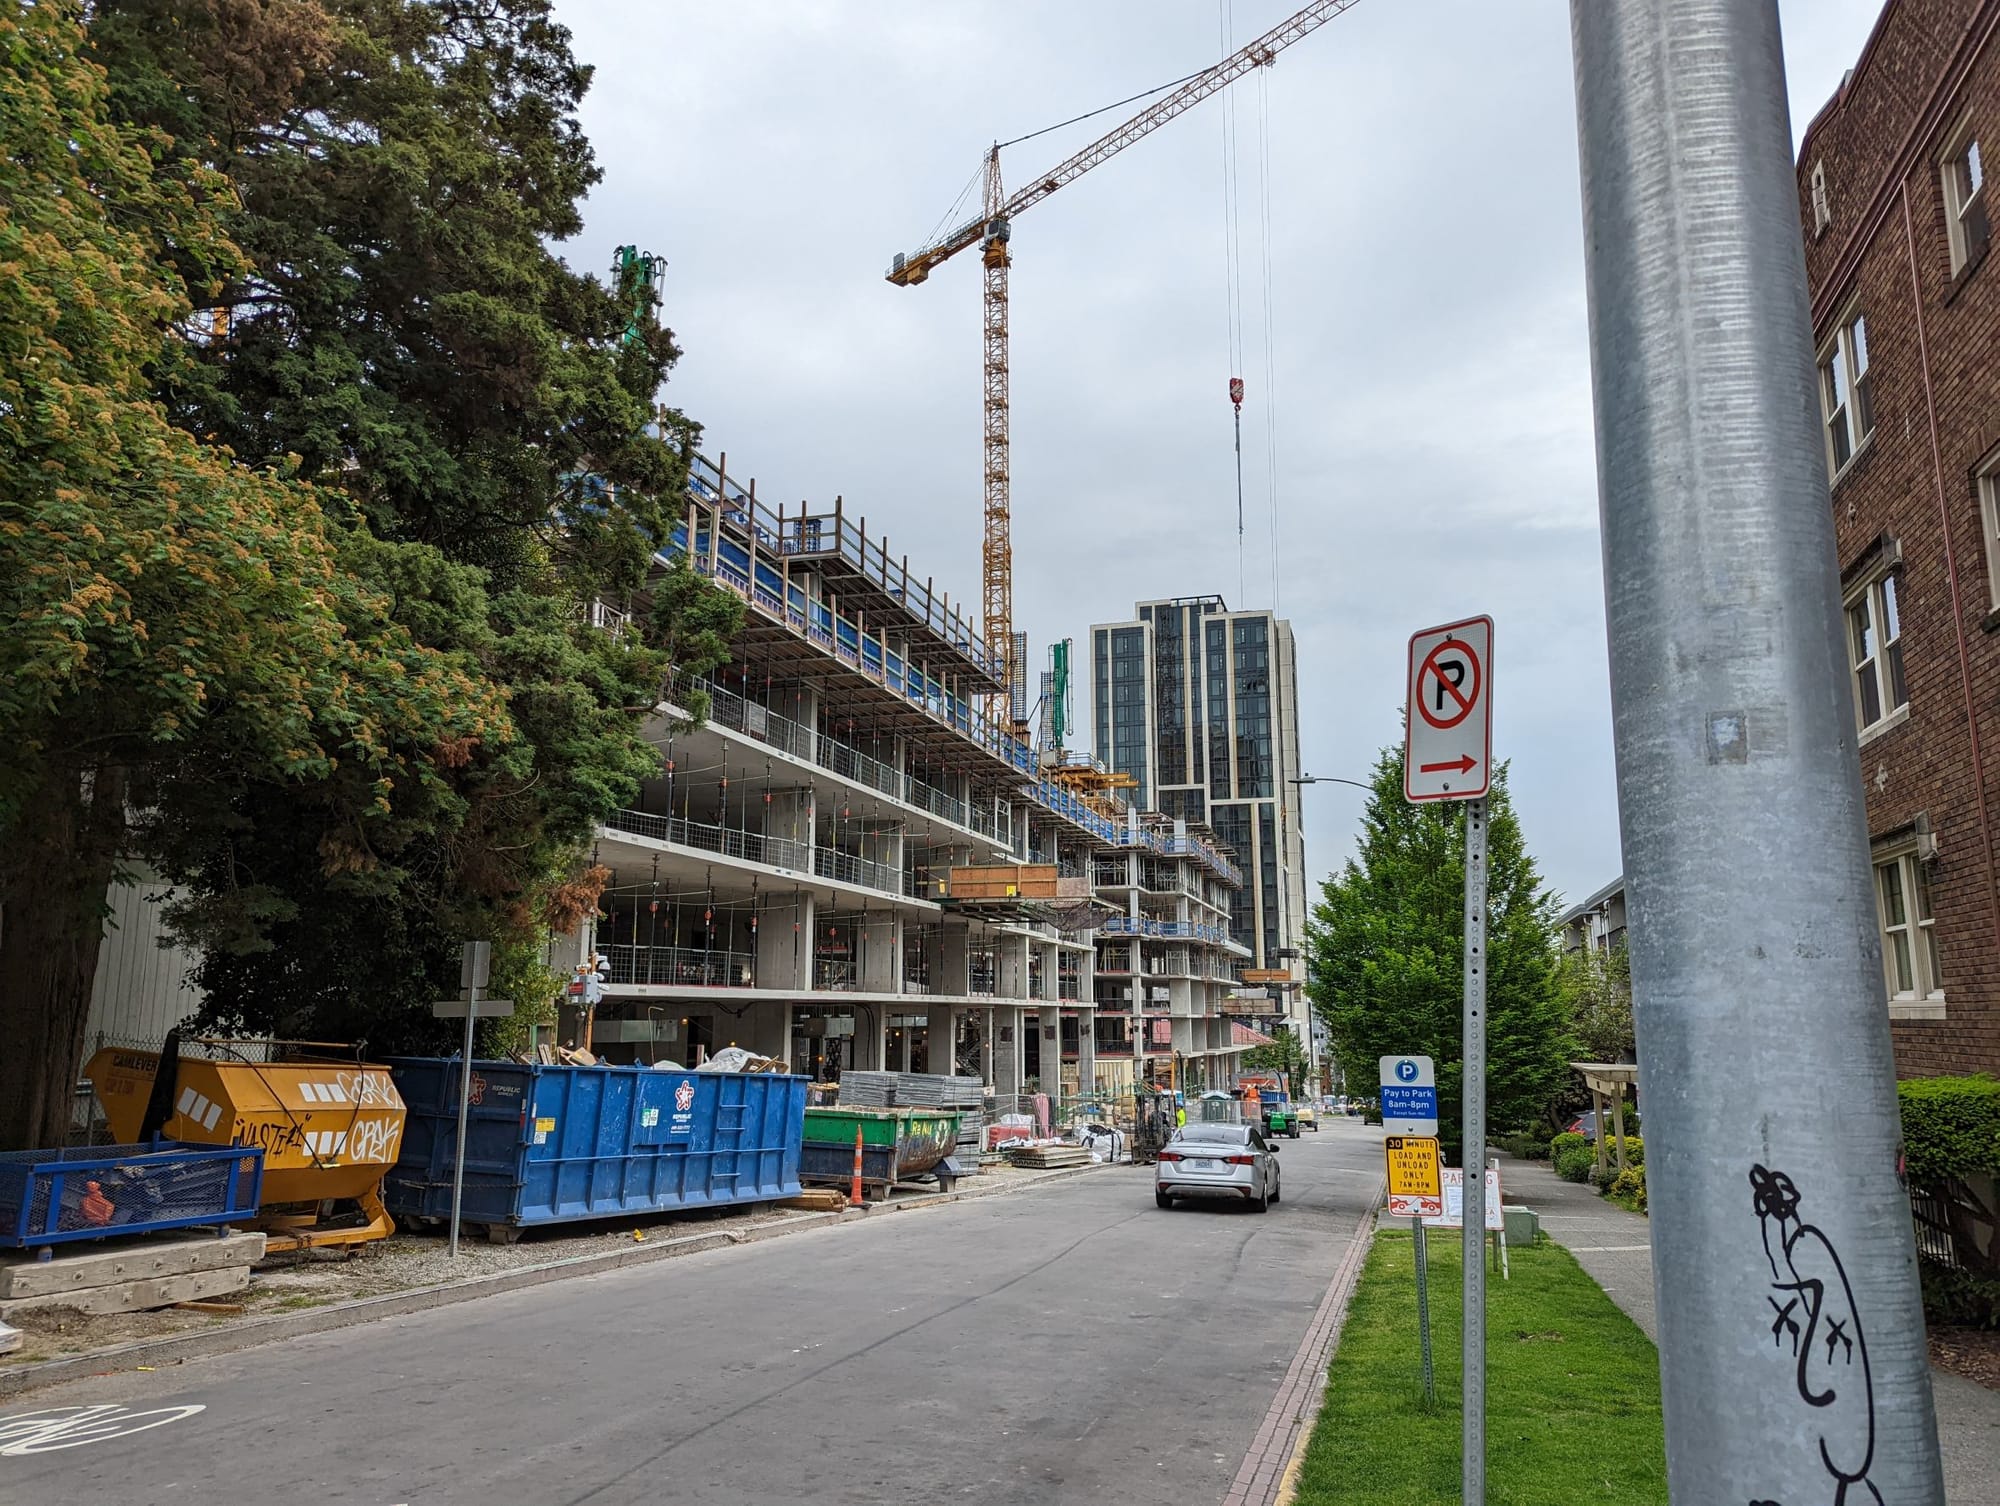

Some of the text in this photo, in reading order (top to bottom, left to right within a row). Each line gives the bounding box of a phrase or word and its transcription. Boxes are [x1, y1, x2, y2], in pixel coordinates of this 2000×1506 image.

[1436, 660, 1465, 710] P
[1402, 1064, 1414, 1078] P
[492, 1085, 521, 1094] REPUBLIC
[1384, 1089, 1433, 1098] Pay to Park
[1388, 1100, 1430, 1110] 8am-8pm
[1389, 1140, 1401, 1148] 30
[1394, 1152, 1431, 1160] LOAD AND
[1397, 1161, 1429, 1169] UNLOAD
[1404, 1171, 1424, 1179] ONLY
